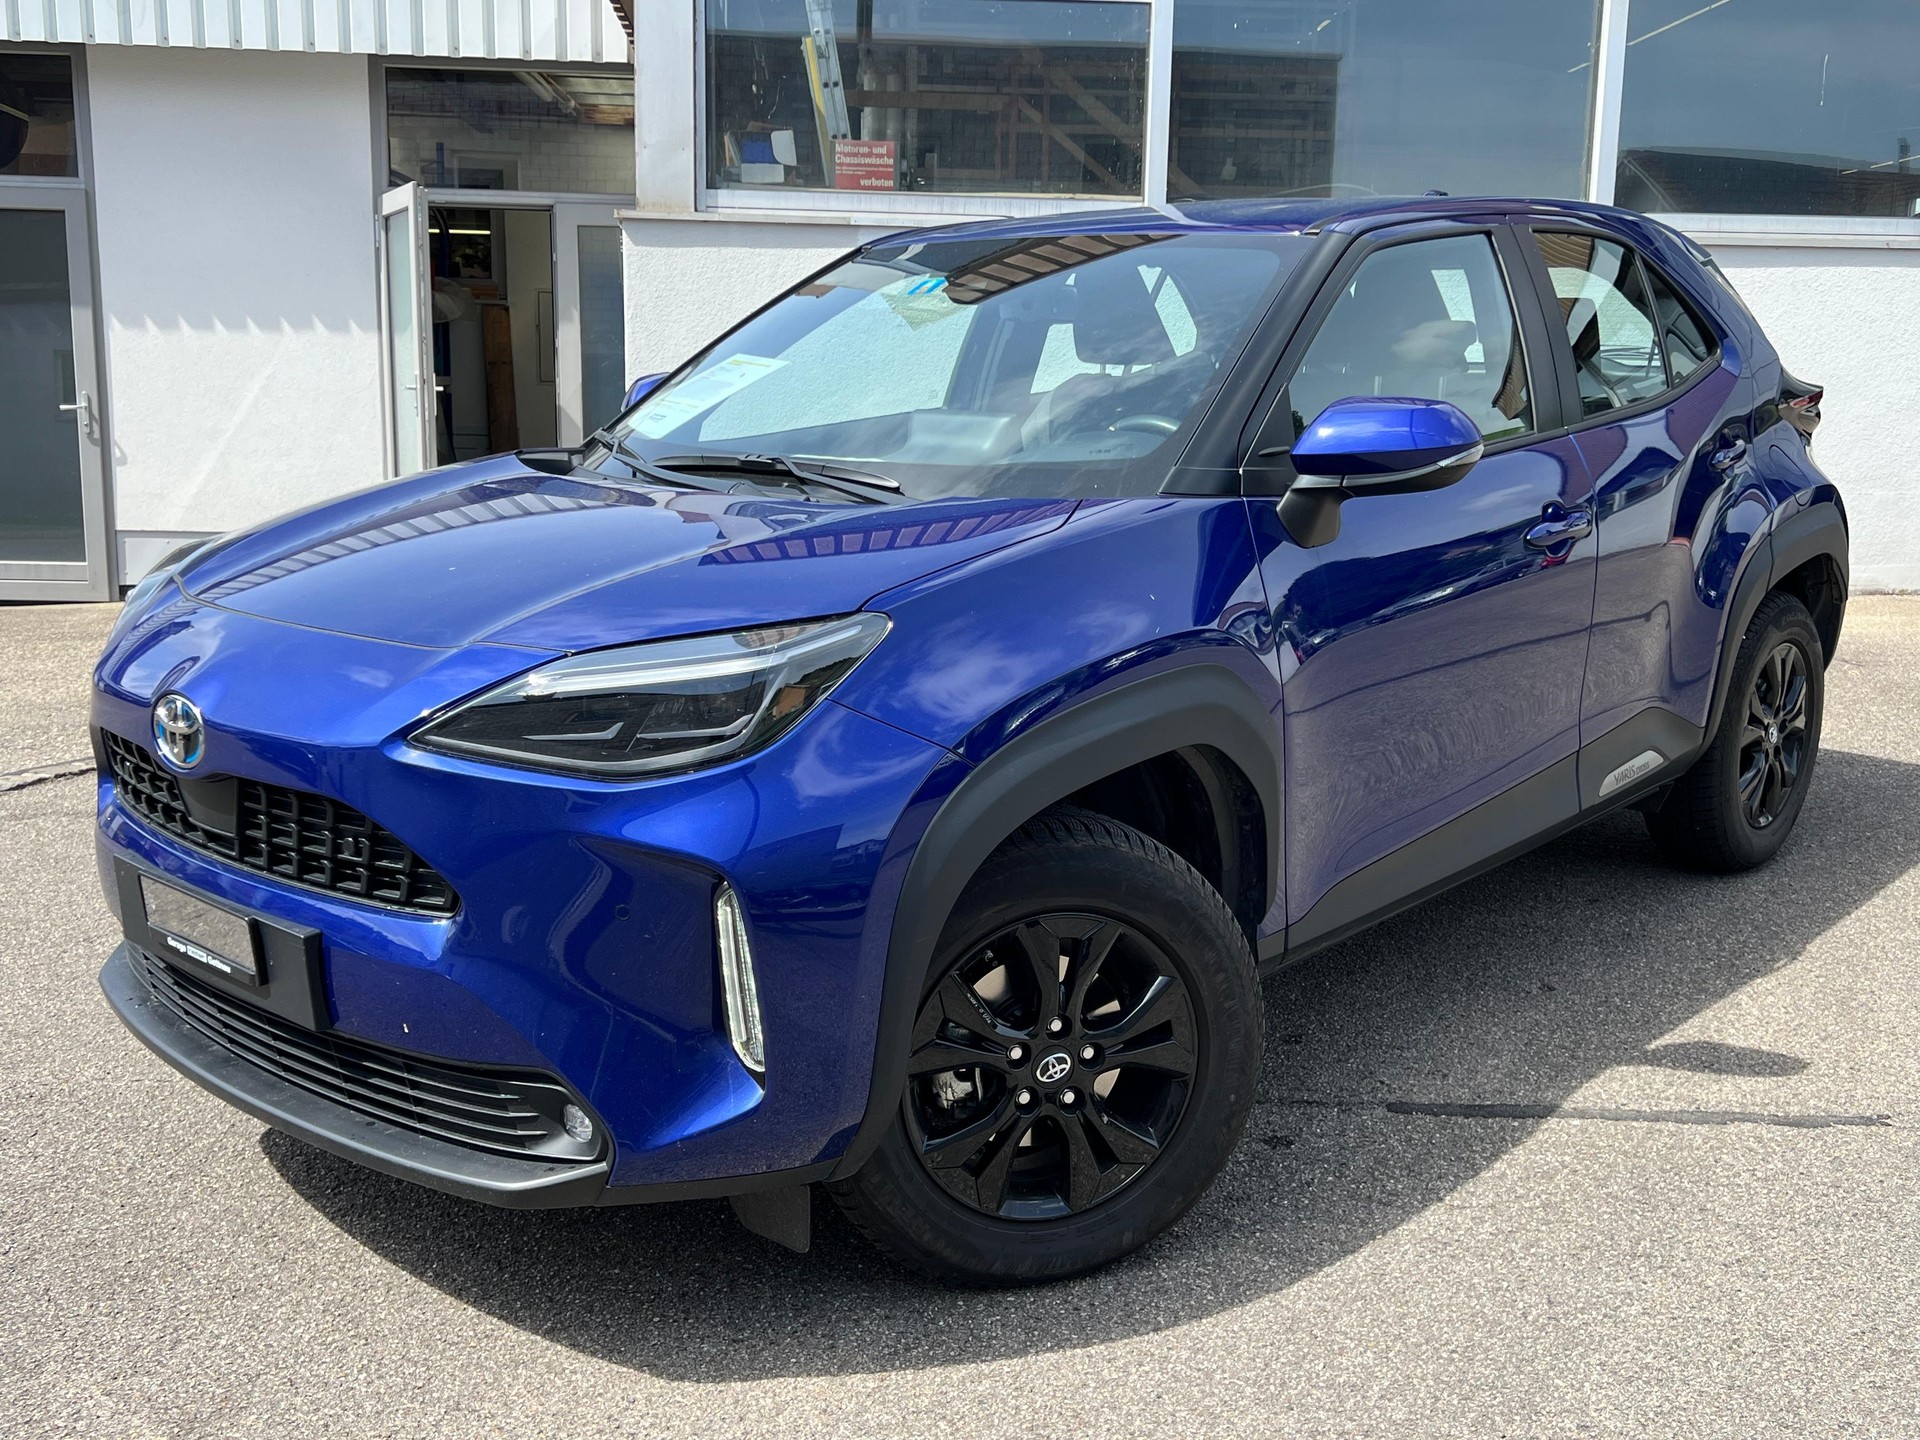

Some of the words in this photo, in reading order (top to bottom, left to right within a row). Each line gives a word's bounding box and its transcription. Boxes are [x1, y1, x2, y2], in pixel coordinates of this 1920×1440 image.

[835, 143, 871, 153] Motoren-
[872, 145, 887, 154] und
[835, 154, 894, 165] Chassiswäsche
[860, 177, 894, 187] verboten
[1613, 764, 1636, 786] YARIS
